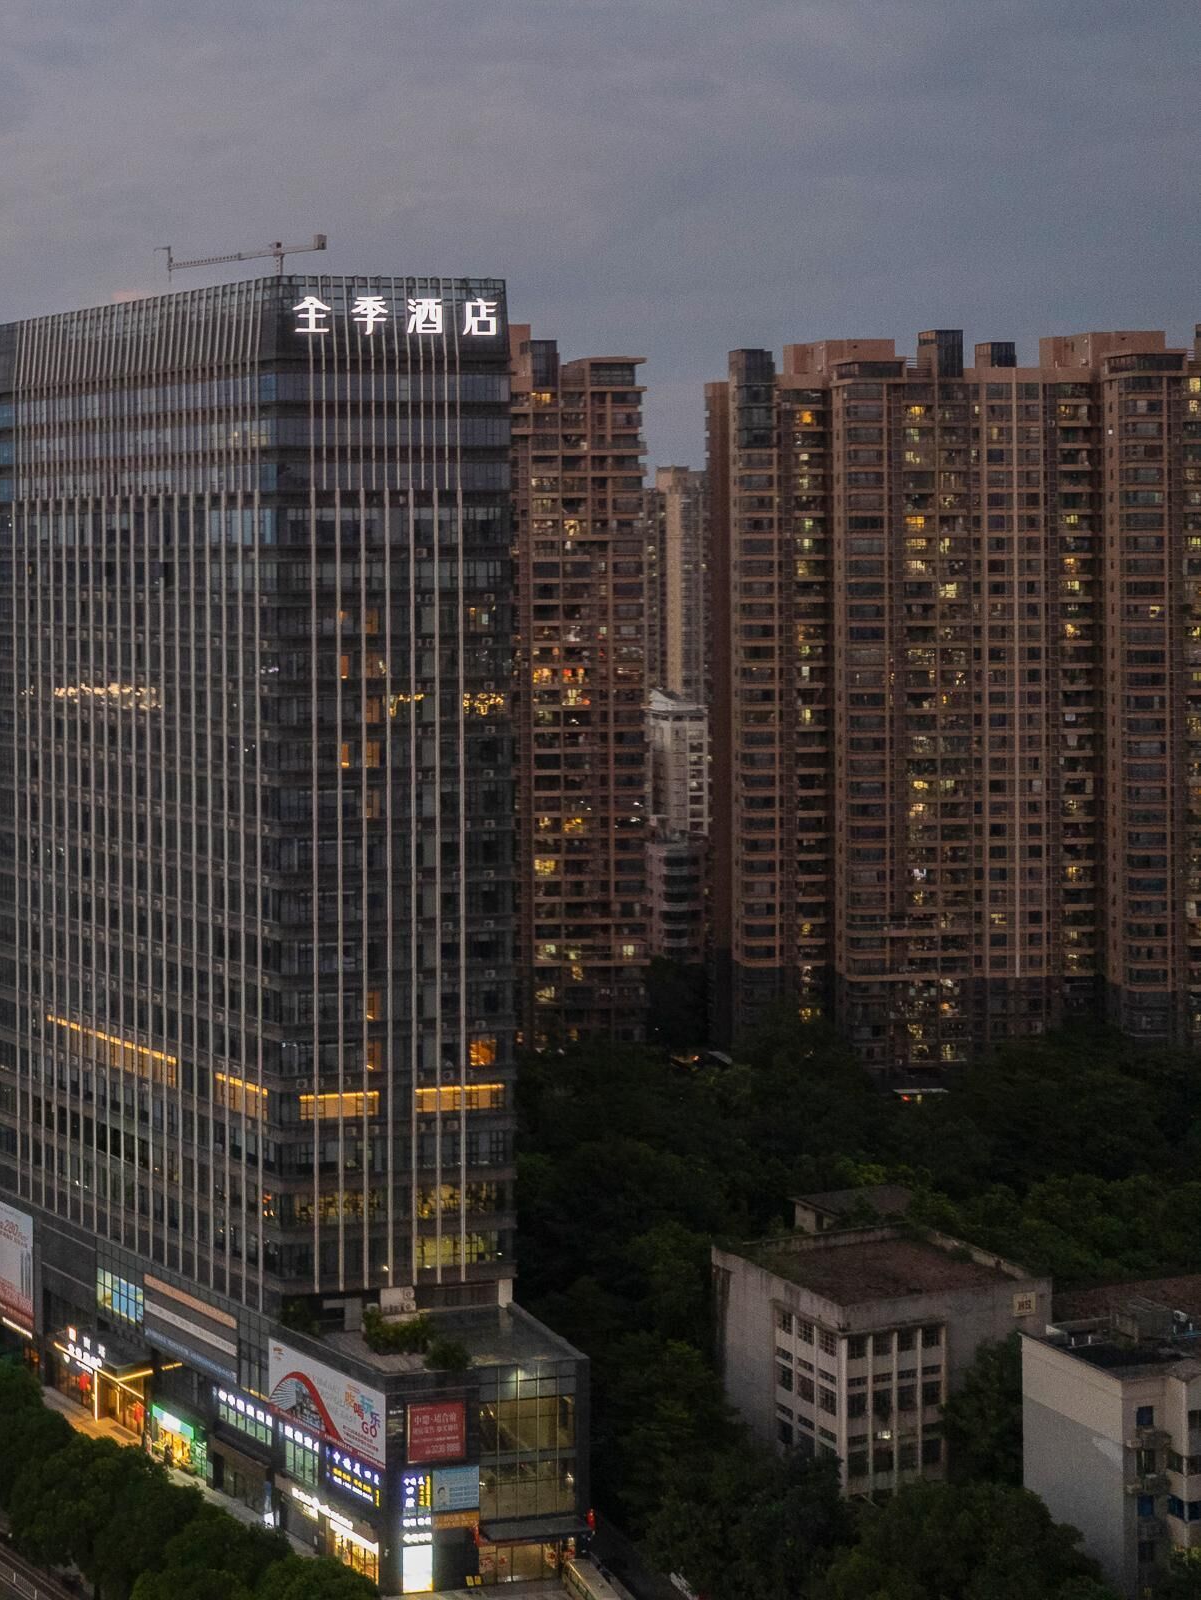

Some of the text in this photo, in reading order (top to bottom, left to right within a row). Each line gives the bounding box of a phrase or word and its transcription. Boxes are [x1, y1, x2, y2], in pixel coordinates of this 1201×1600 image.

[292, 296, 497, 336] 全季酒店
[361, 1421, 378, 1438] GO
